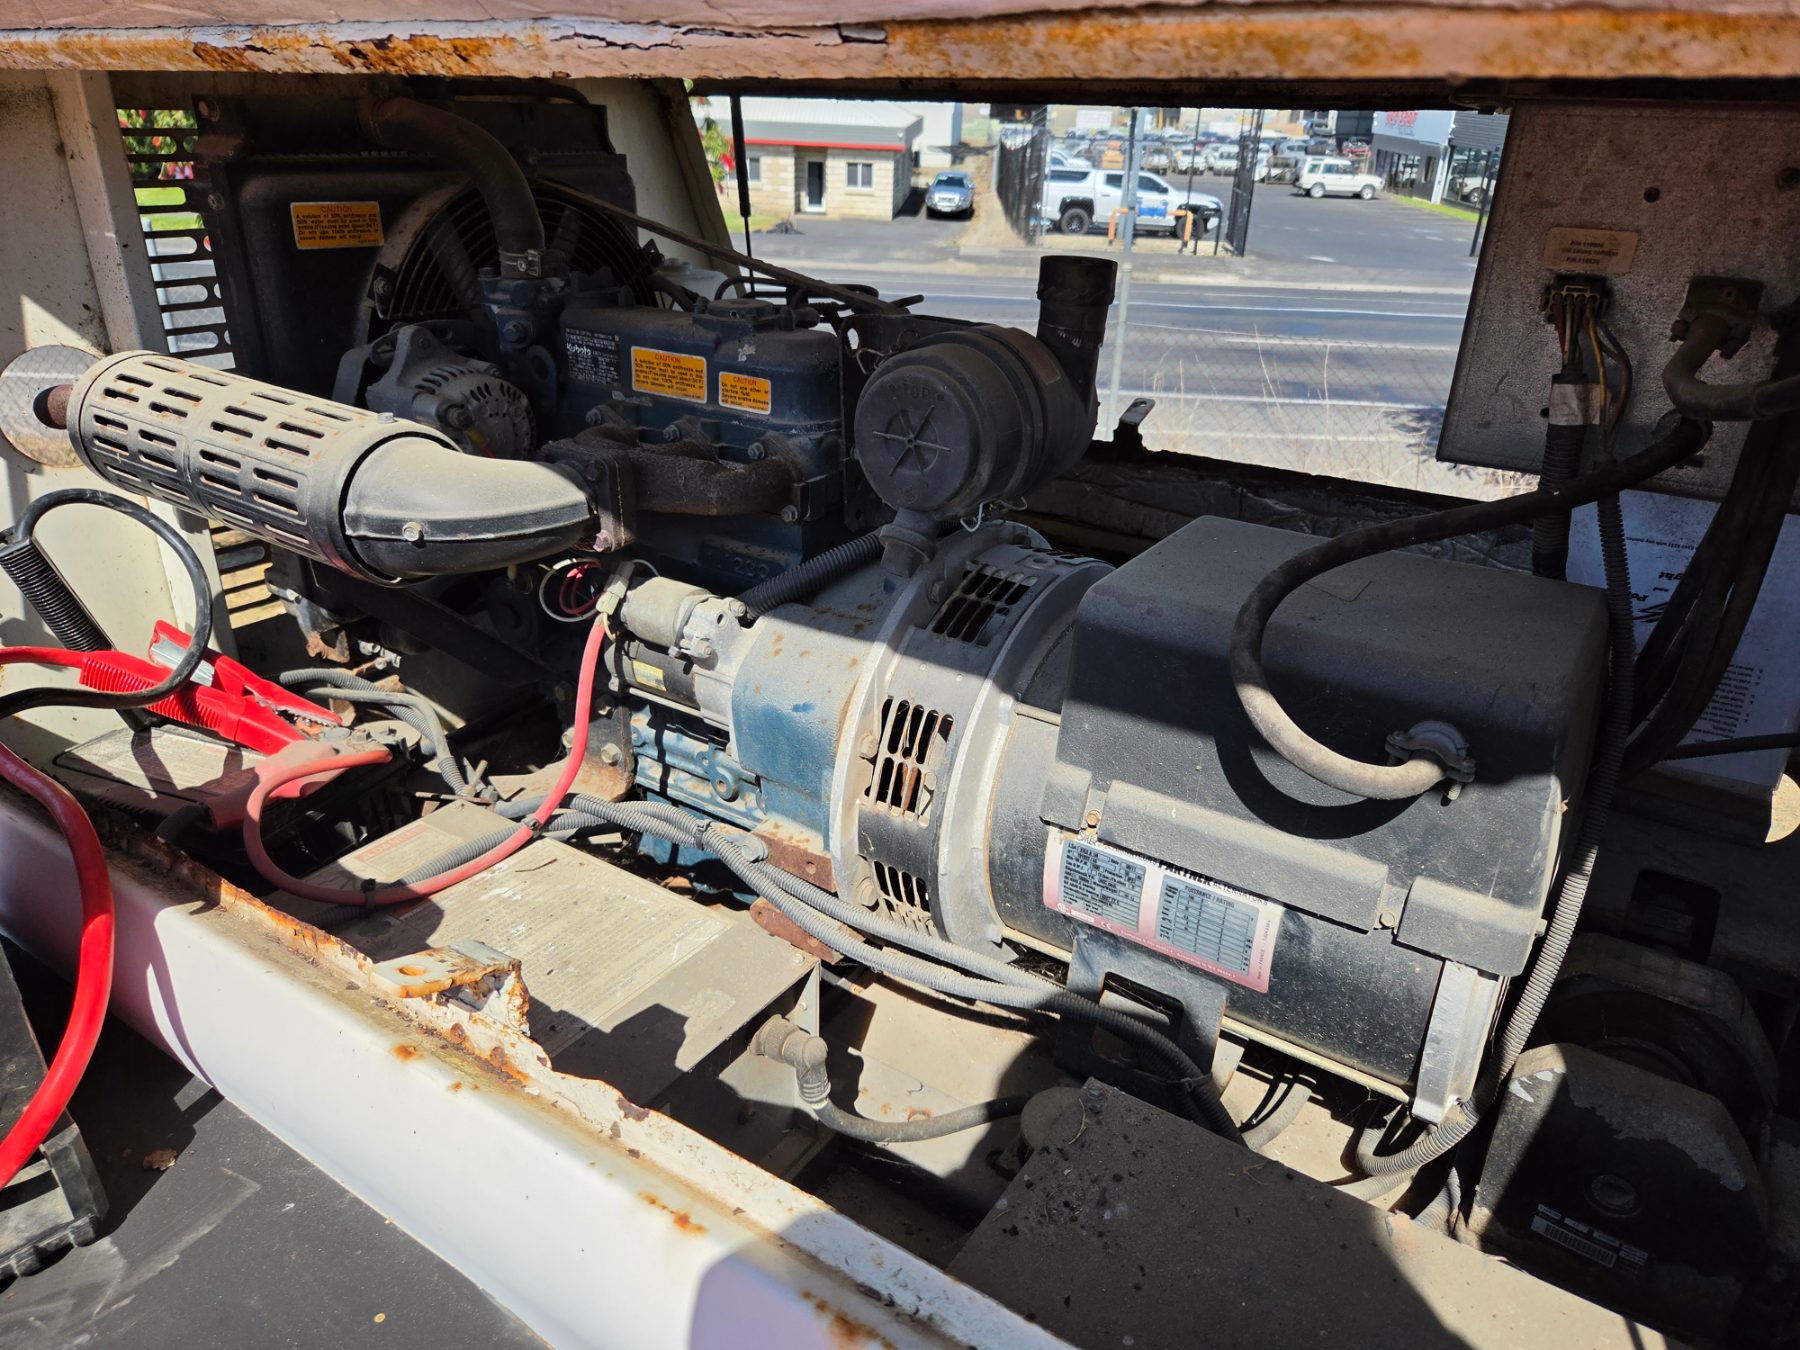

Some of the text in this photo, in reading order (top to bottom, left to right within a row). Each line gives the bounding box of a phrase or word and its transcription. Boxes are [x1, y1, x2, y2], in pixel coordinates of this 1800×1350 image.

[321, 205, 352, 213] CAUTION
[567, 343, 591, 355] Kubota
[655, 353, 681, 363] CAUTION
[733, 376, 757, 386] CAUTION
[903, 383, 930, 400] TOP
[1184, 885, 1212, 900] PUISSANCE
[1217, 897, 1235, 908] RATING
